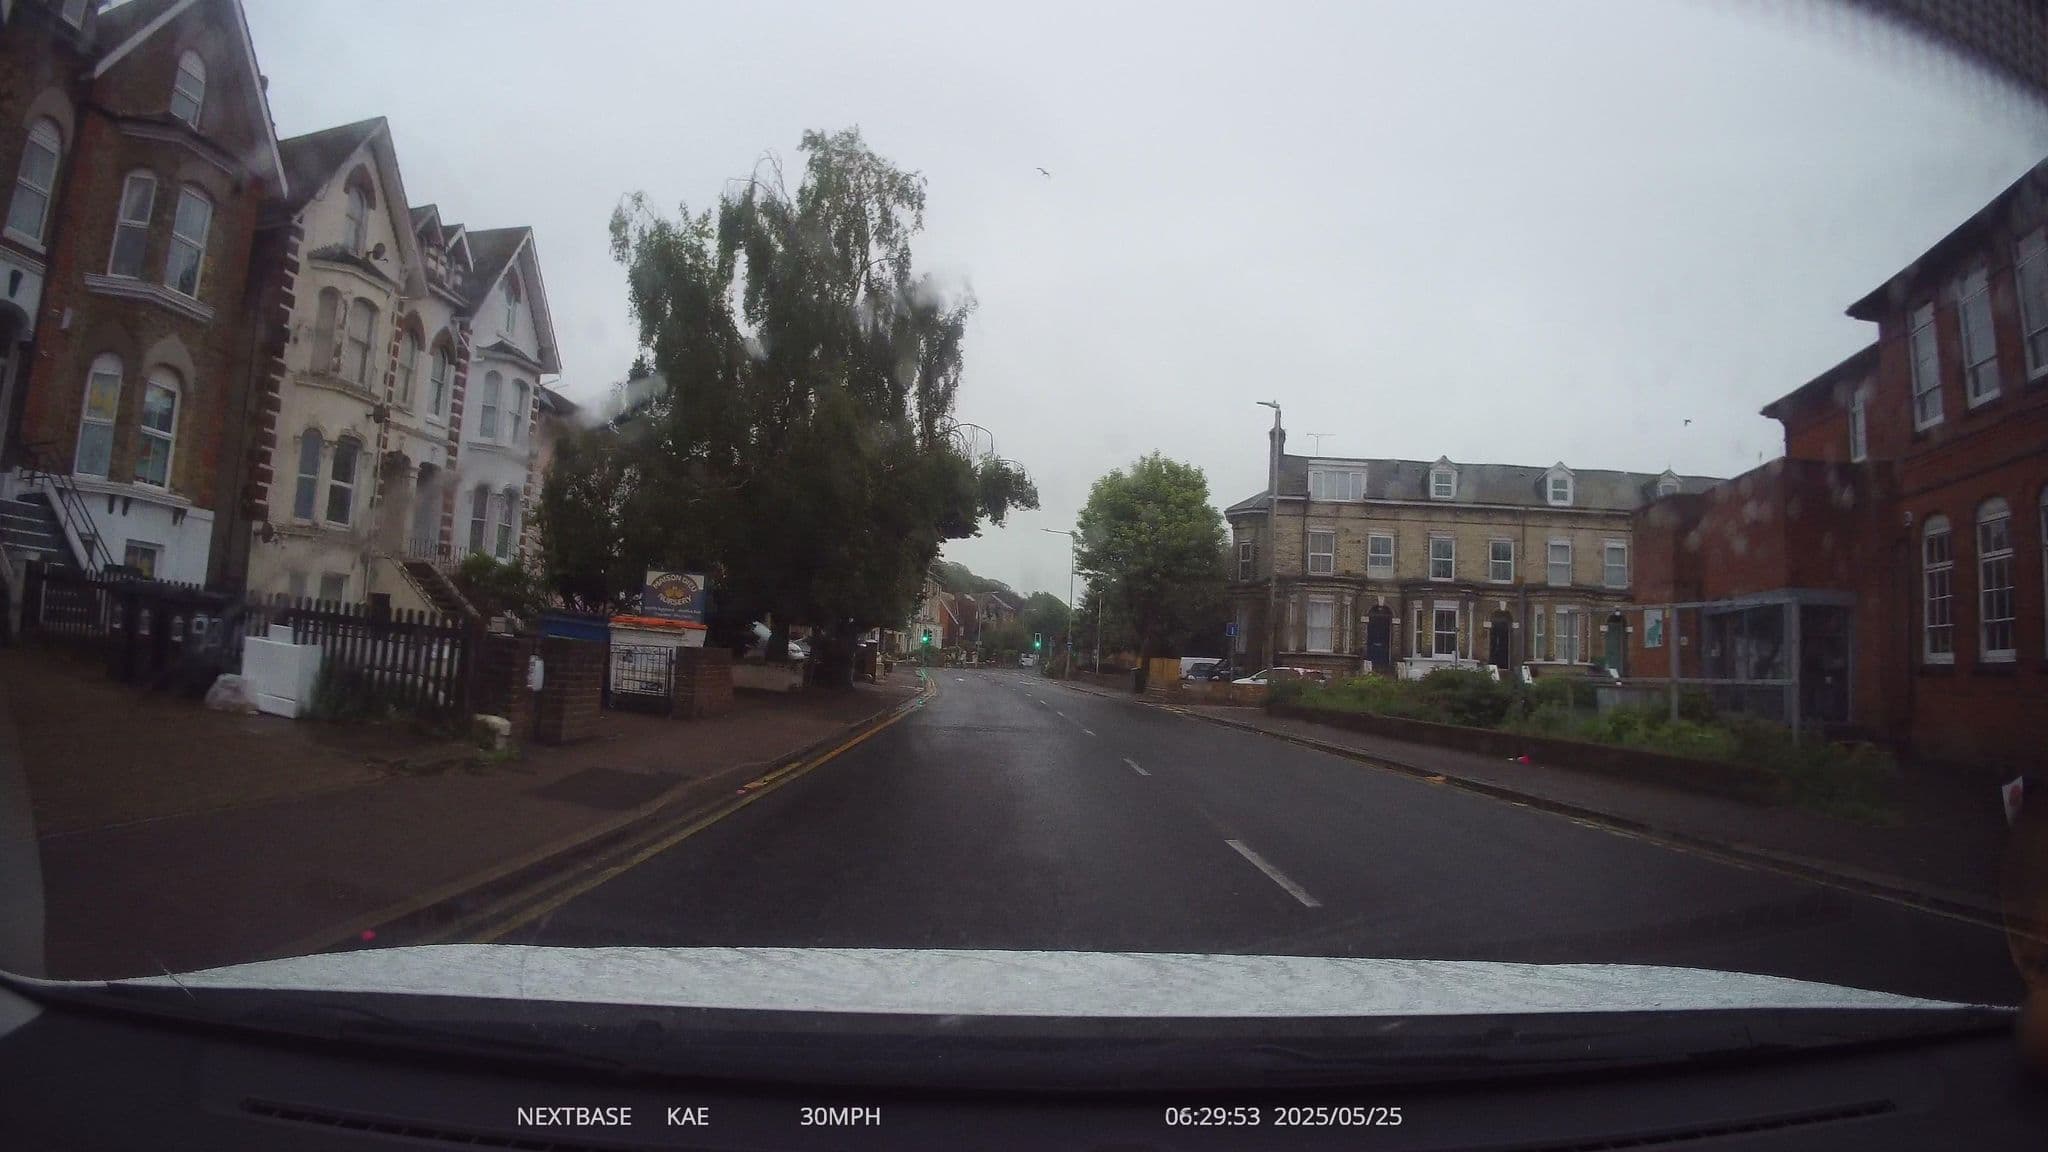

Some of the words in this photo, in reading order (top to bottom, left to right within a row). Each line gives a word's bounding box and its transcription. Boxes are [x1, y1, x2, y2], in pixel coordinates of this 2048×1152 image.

[652, 574, 682, 590] MAISON
[682, 577, 698, 592] DIEU
[657, 593, 692, 606] NURSERY
